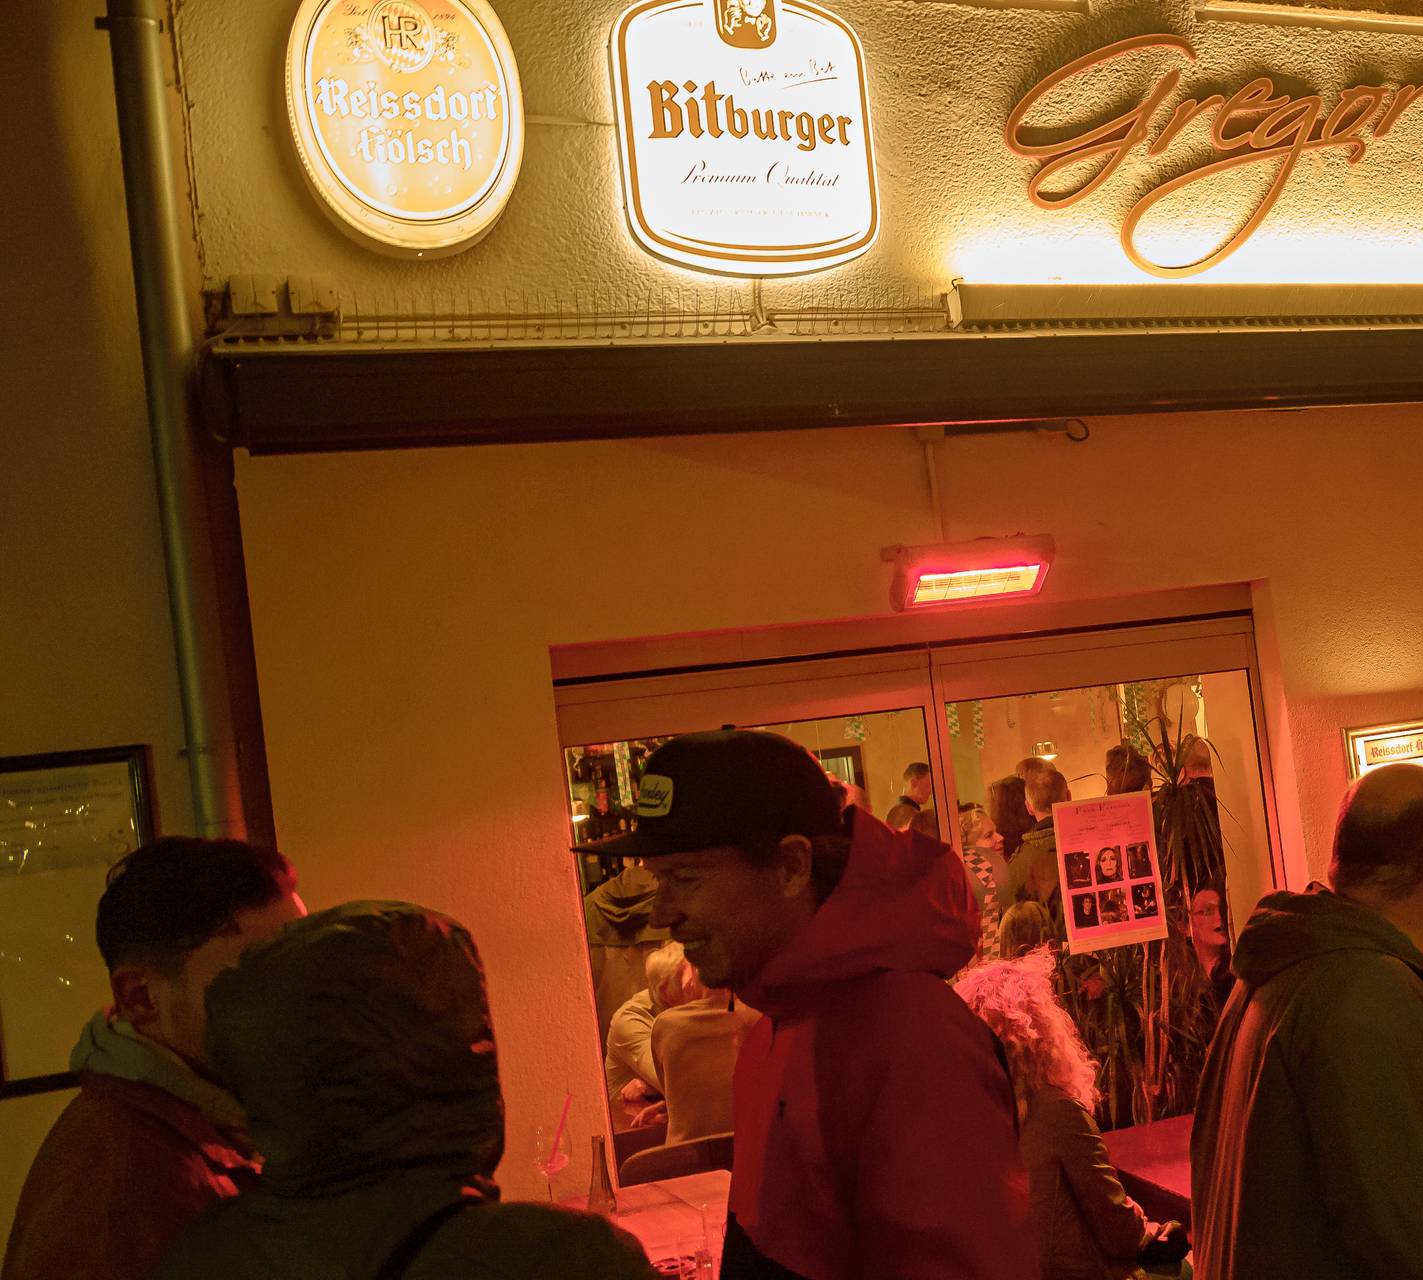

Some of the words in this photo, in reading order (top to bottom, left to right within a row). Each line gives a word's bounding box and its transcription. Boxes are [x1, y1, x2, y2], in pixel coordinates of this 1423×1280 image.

[315, 76, 500, 121] Reissdorf
[647, 79, 852, 152] Bitburger
[356, 126, 473, 170] Kölsch
[680, 159, 757, 185] Premium
[1371, 742, 1414, 759] Reissdorf
